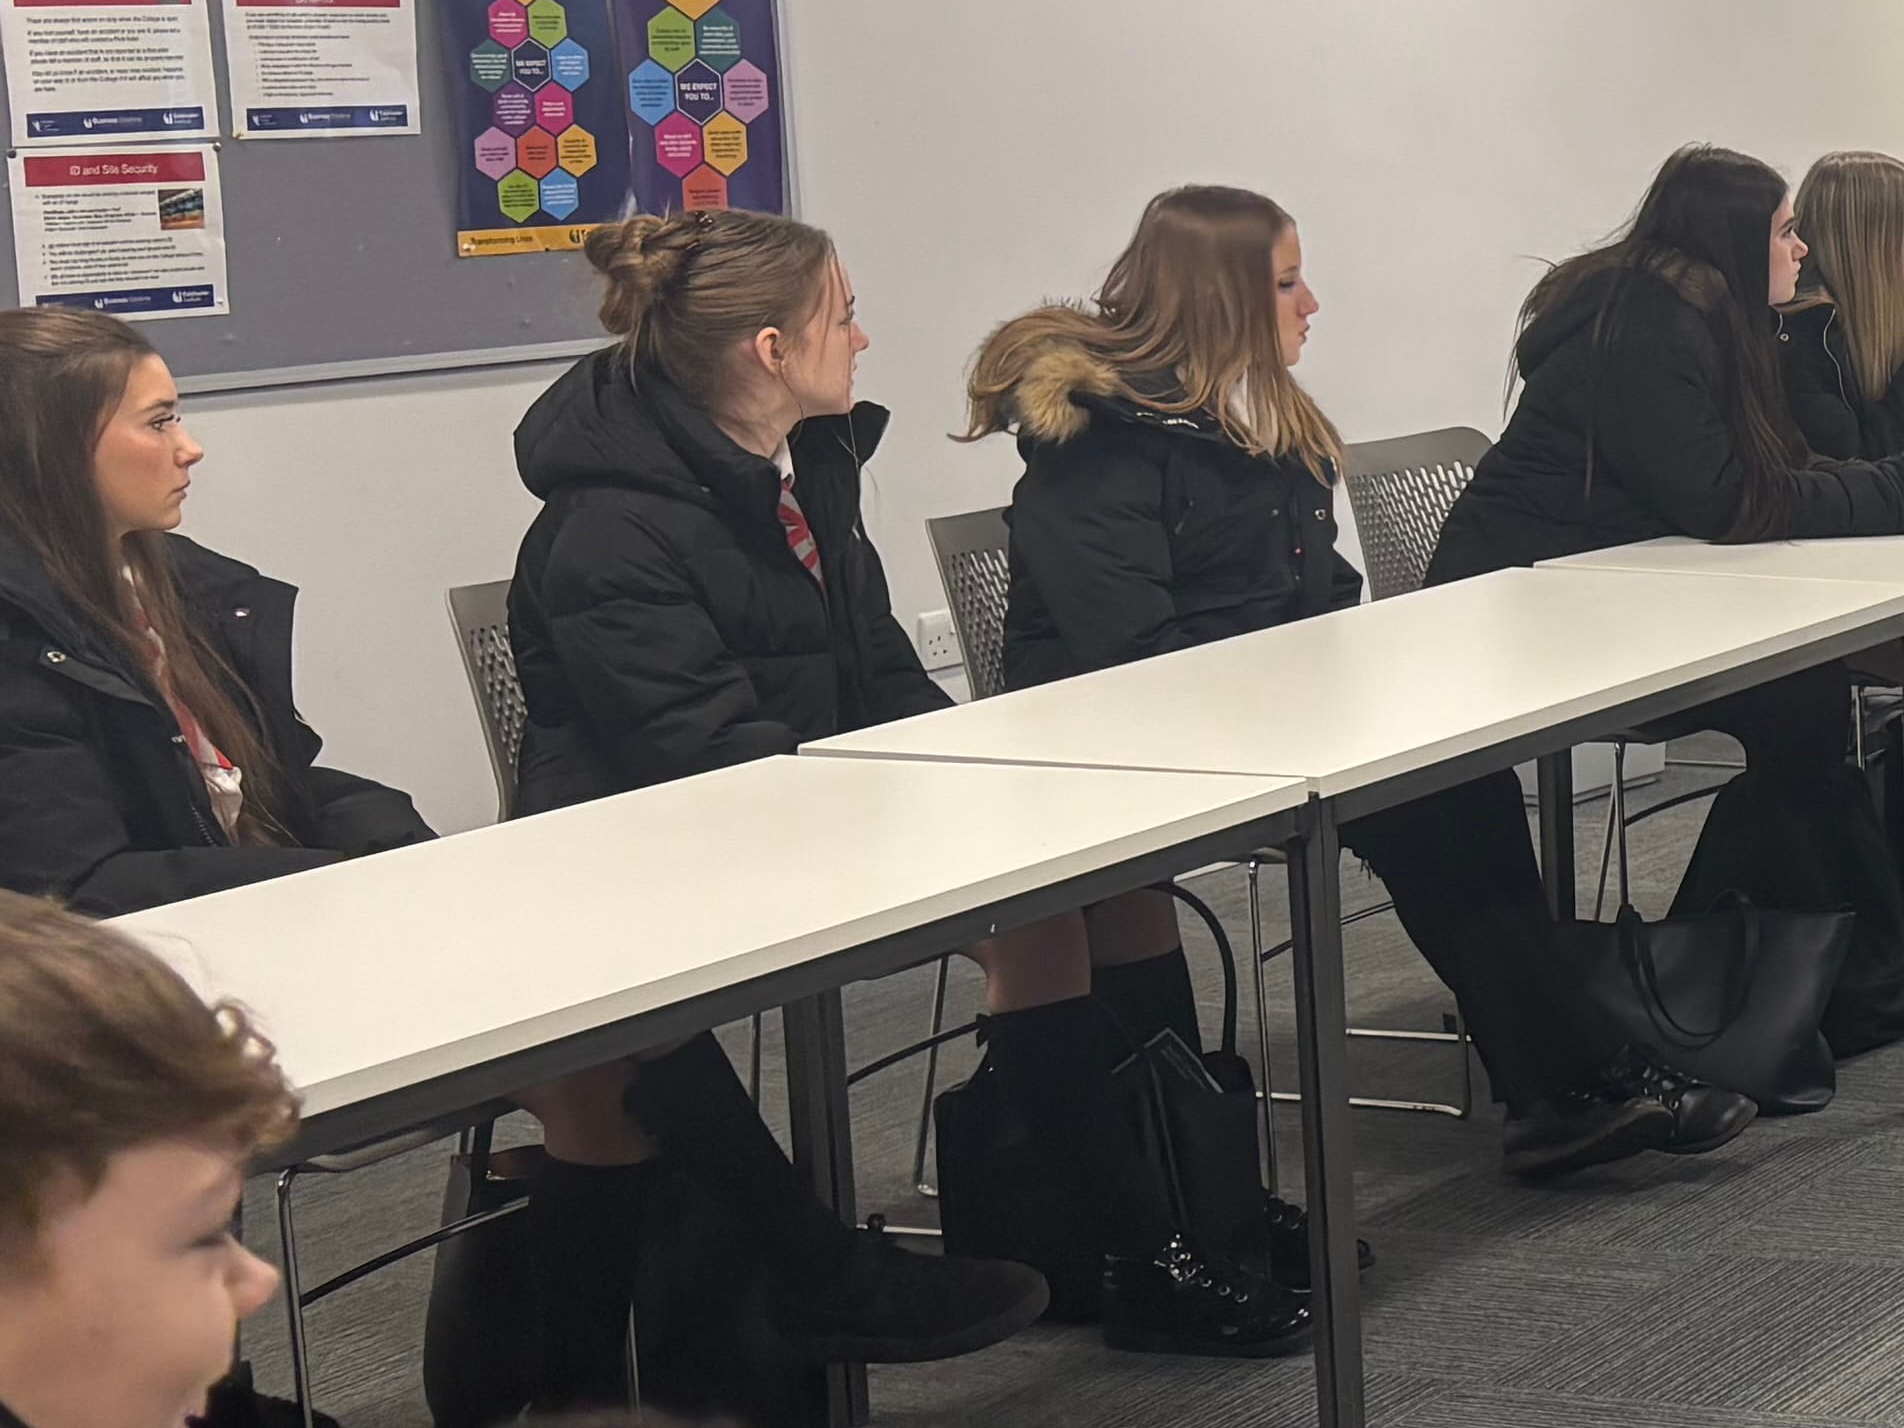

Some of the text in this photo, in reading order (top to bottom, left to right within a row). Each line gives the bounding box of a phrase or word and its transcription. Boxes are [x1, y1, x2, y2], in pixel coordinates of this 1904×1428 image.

[680, 82, 717, 91] WE EXPECT
[684, 92, 699, 101] YOU
[69, 162, 159, 176] ID and Site Security
